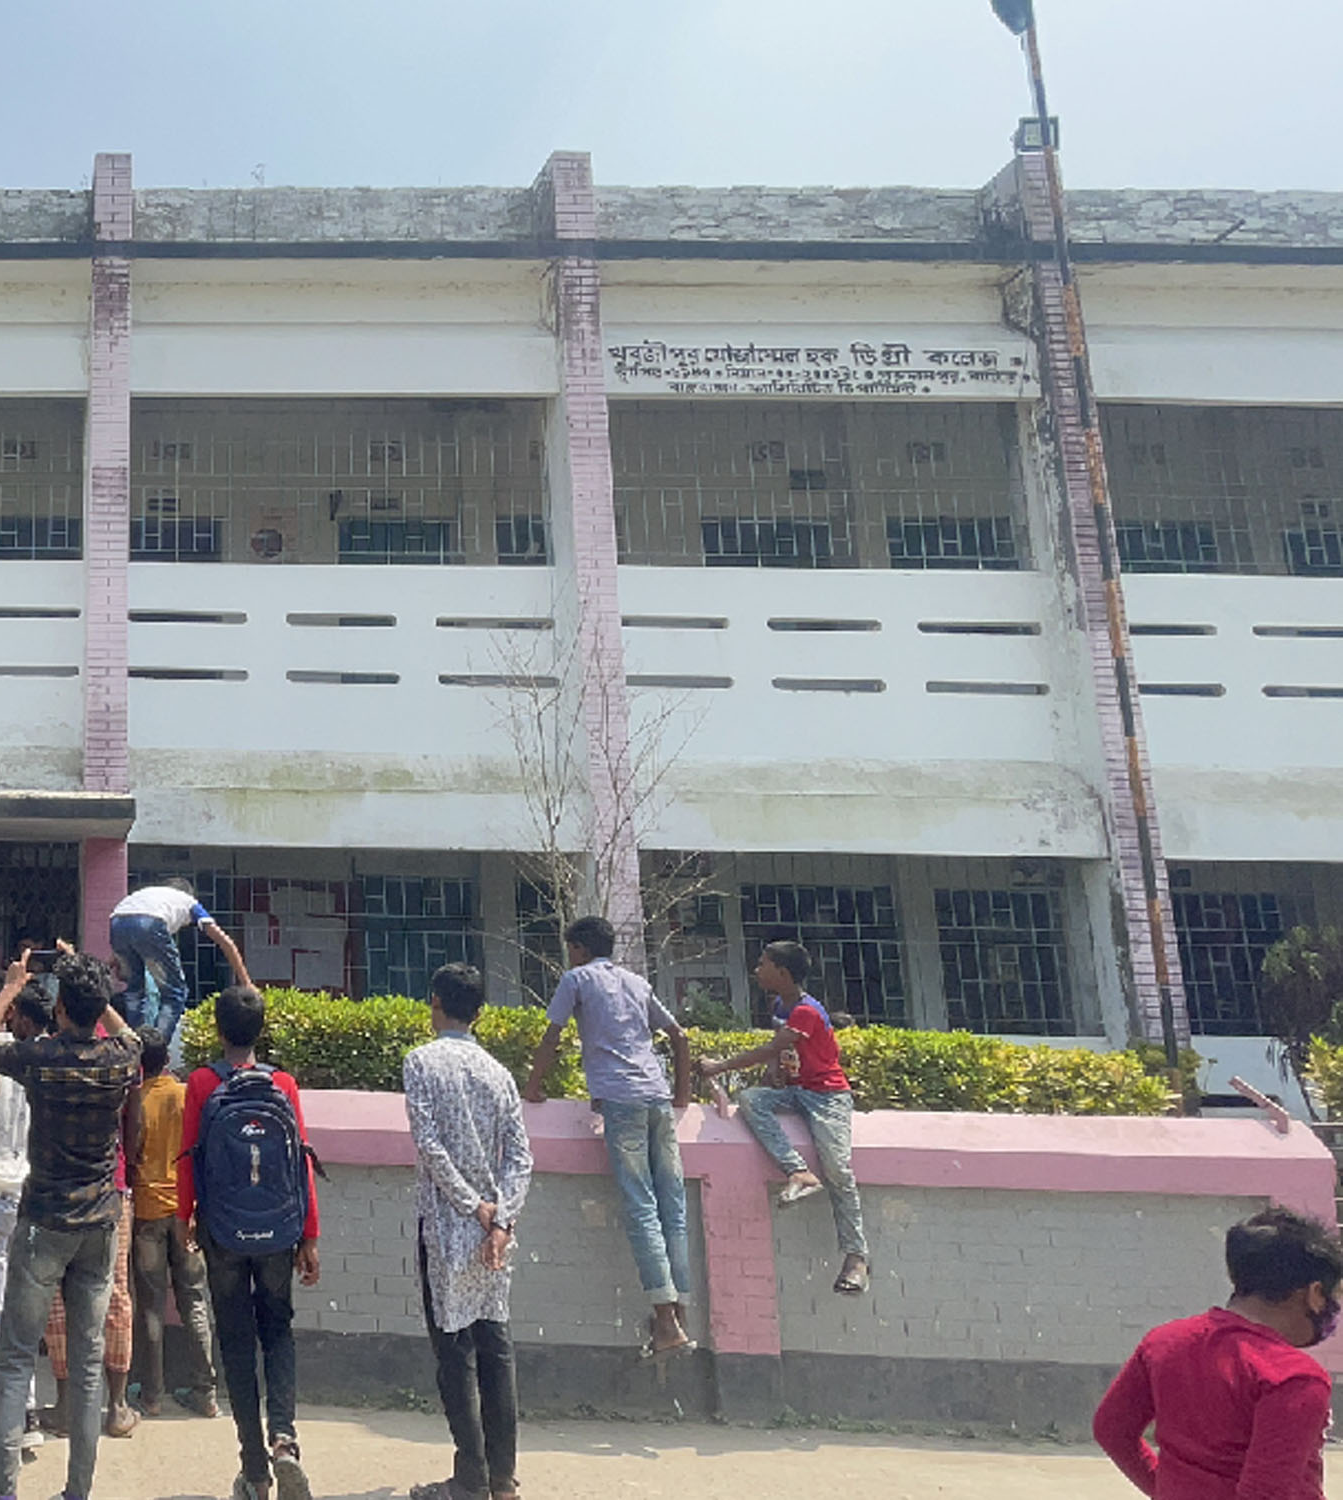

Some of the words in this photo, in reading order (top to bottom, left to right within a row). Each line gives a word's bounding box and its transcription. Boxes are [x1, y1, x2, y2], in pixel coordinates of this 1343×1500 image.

[805, 348, 839, 366] হক
[850, 341, 912, 366] ডিগ্রী
[922, 349, 1000, 368] কলেজ
